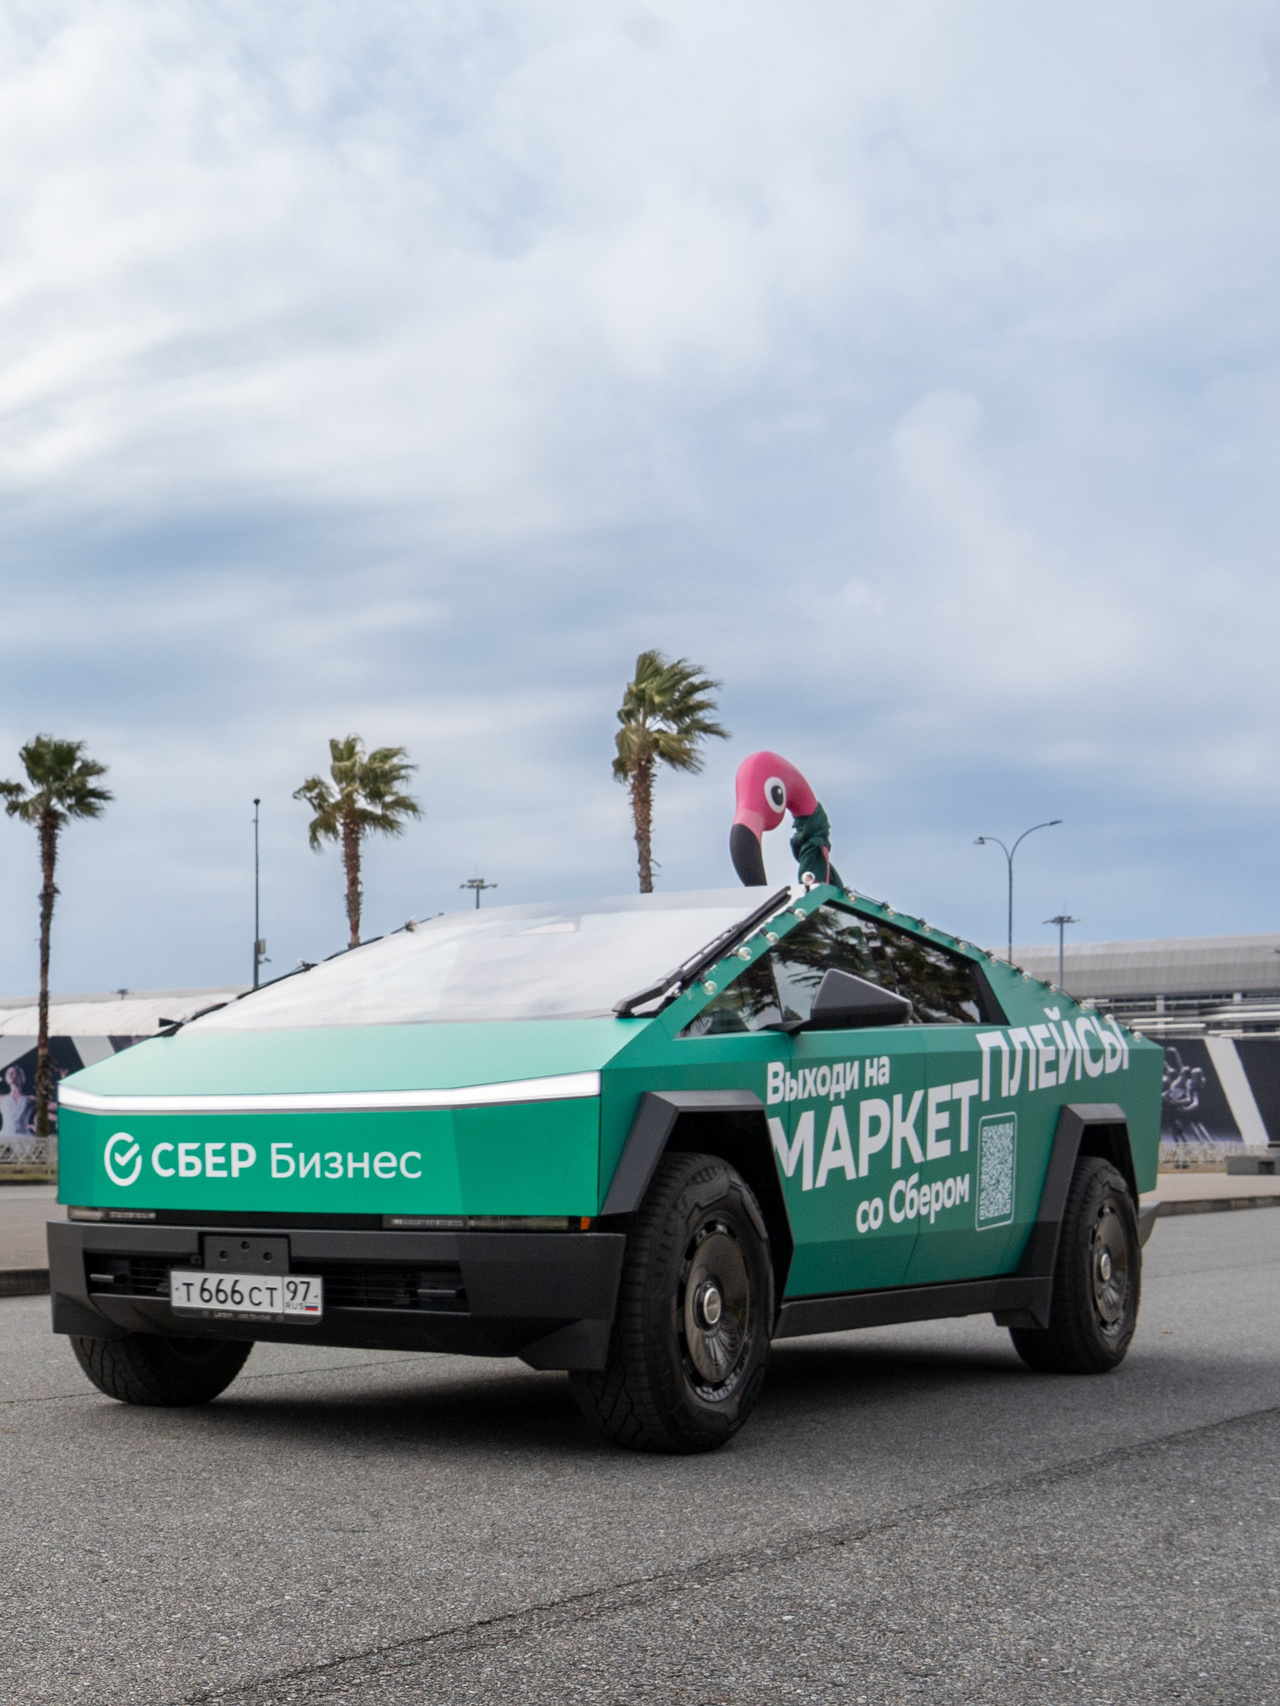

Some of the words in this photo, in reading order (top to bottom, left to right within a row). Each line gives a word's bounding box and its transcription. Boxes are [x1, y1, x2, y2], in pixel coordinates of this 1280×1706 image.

[975, 1007, 1130, 1102] ПЛЕЙСЫ
[766, 1060, 860, 1106] Выходи
[864, 1055, 891, 1088] на
[768, 1078, 980, 1192] МАРКЕТ
[151, 1142, 257, 1178] СБЕР
[270, 1142, 422, 1180] Бизнес
[855, 1196, 884, 1234] со
[888, 1172, 970, 1225] Сбером
[285, 1280, 311, 1302] 97
[285, 1301, 304, 1311] RUS
